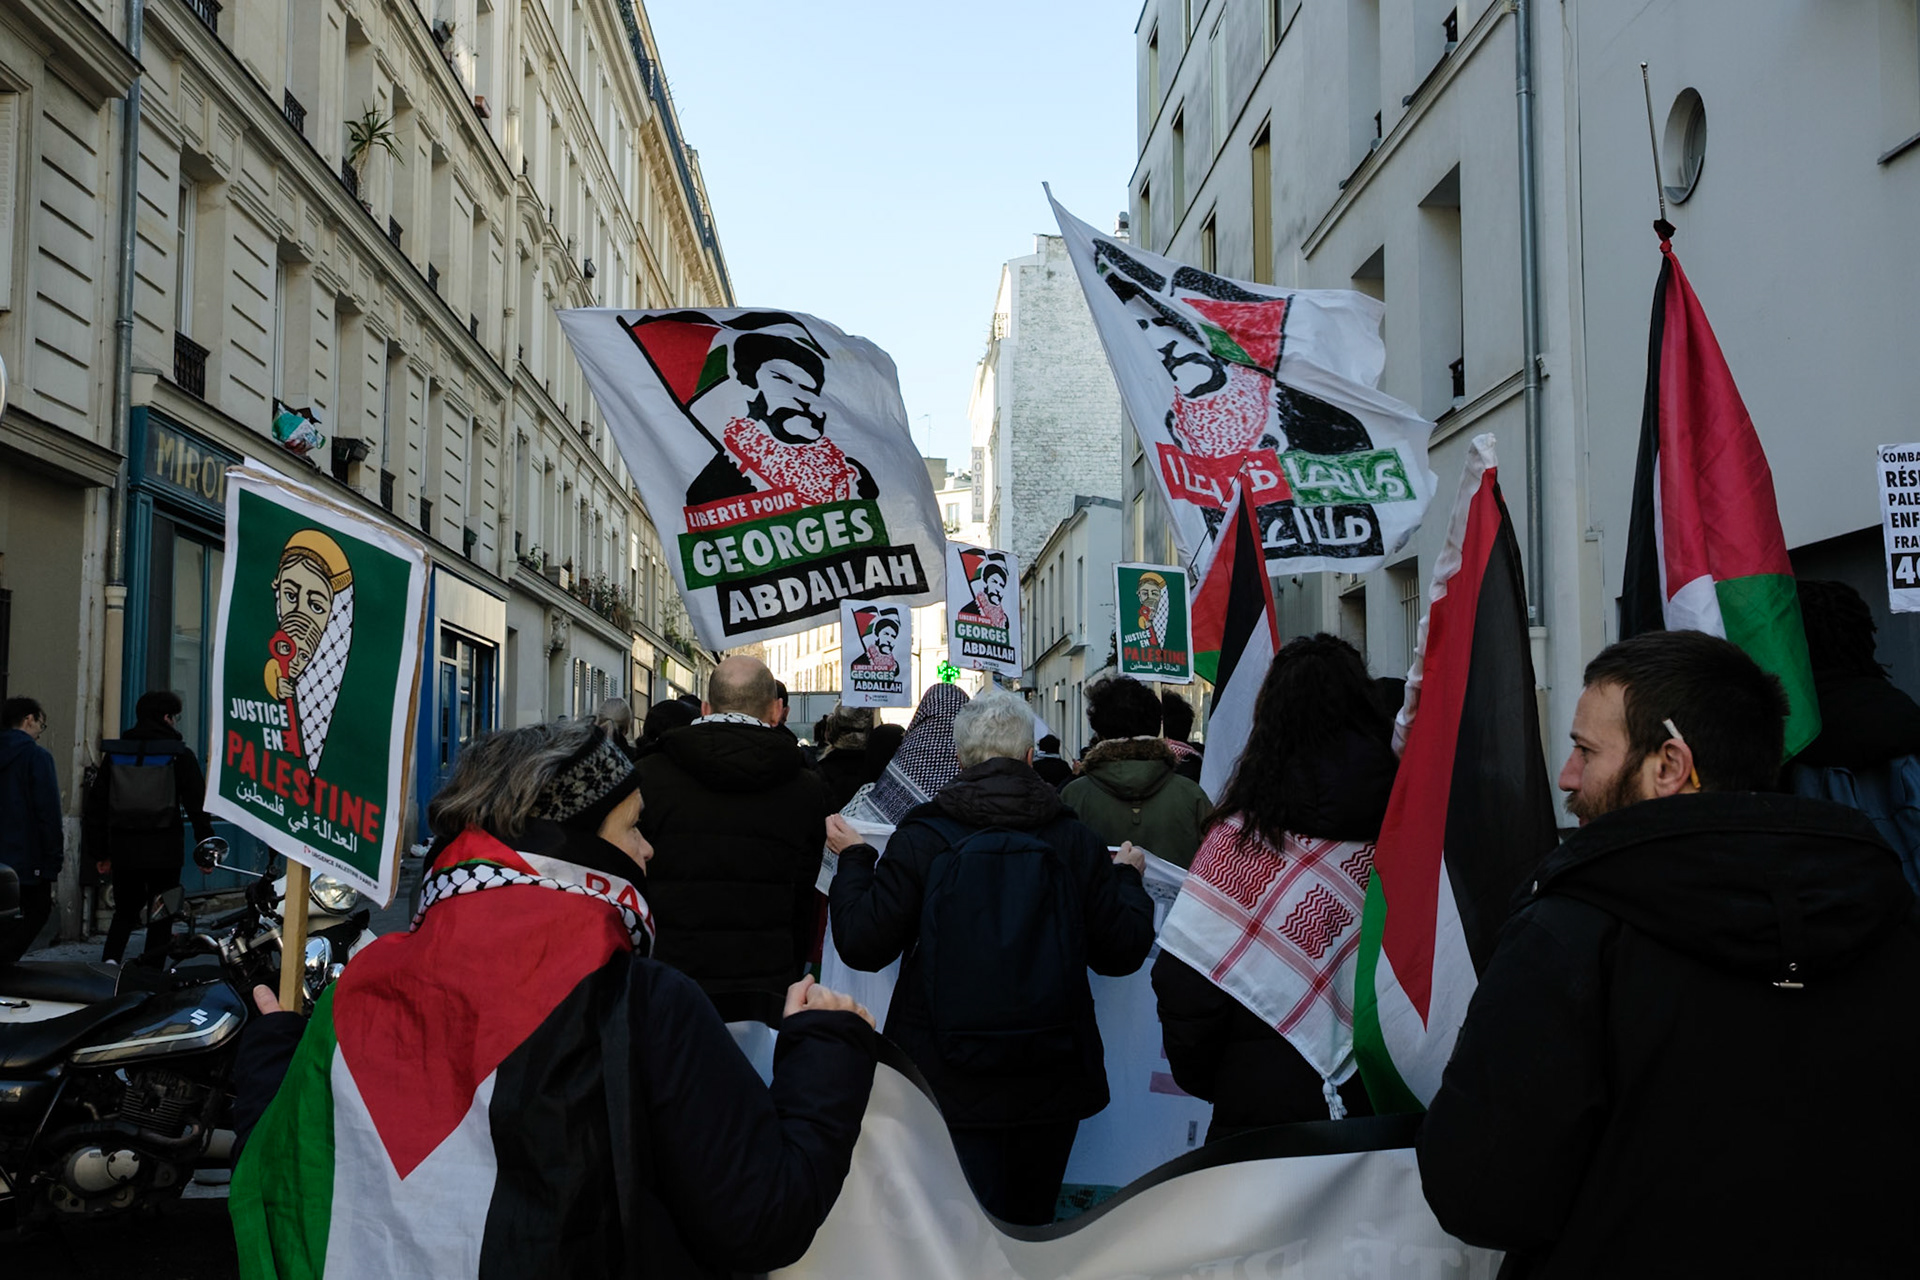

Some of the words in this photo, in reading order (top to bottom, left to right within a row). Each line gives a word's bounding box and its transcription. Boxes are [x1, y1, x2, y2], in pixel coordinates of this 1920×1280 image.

[974, 450, 982, 507] HOTEL
[688, 499, 749, 529] LIBERTÉ
[750, 492, 797, 515] POUR
[692, 508, 874, 577] GEORGES
[1894, 535, 1920, 549] FRA
[729, 554, 918, 625] ABDALLAH
[957, 623, 1007, 644] GEORGES
[1124, 630, 1151, 643] JUSTICE
[1140, 639, 1150, 648] EN
[963, 641, 1014, 662] ABDALLAH
[1123, 646, 1187, 666] PALESTINE
[851, 670, 895, 680] GEORGES
[855, 681, 902, 692] ABDALLAH
[230, 698, 289, 727] JUSTICE
[262, 727, 284, 751] EN
[226, 729, 381, 843] PALESTINE
[236, 781, 285, 816] فلسطين
[287, 810, 309, 834] في
[312, 815, 358, 853] العدالة
